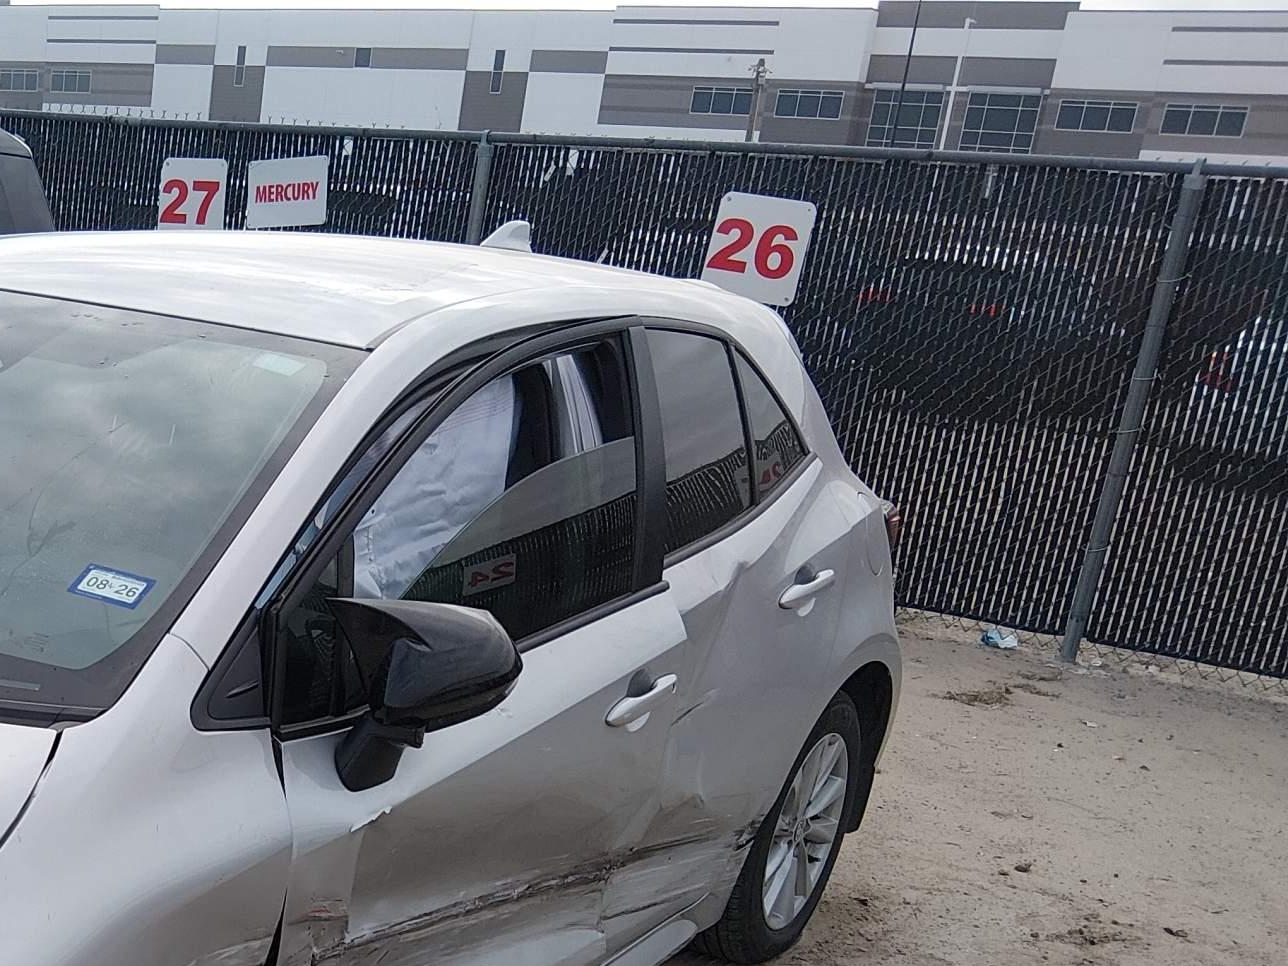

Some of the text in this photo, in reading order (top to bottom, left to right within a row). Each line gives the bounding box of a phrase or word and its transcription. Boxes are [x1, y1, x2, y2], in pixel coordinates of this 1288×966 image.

[159, 178, 221, 225] 27
[254, 181, 320, 204] MERCURY
[706, 217, 799, 280] 26
